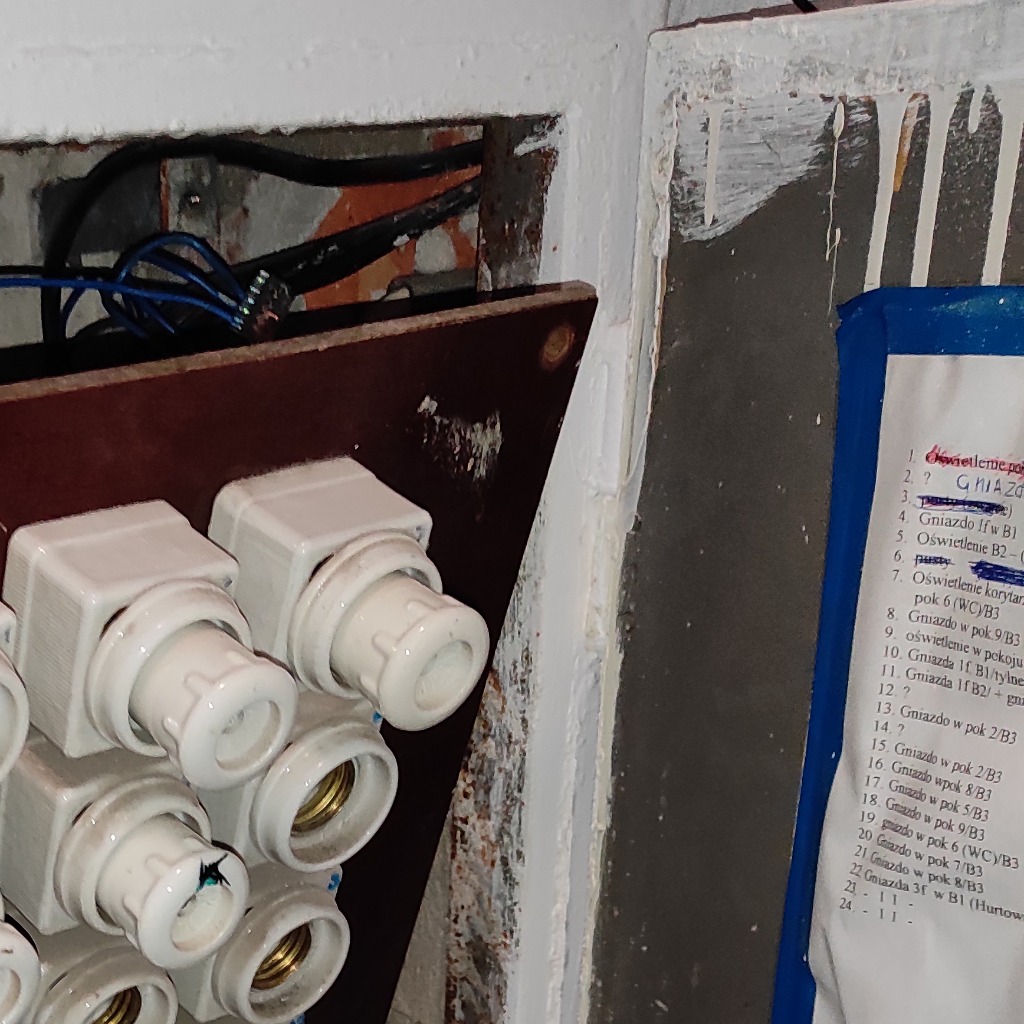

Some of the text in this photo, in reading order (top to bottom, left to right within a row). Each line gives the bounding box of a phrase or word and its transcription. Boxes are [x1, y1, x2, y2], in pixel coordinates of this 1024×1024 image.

[919, 512, 975, 530] Gniazdo
[917, 532, 988, 554] Oświetlenie
[992, 543, 1007, 558] B2
[912, 571, 982, 595] Oświetlenie
[914, 592, 938, 606] pok
[943, 595, 951, 607] 6
[908, 609, 957, 630] Gniazdo
[906, 630, 969, 653] oświetlenie
[984, 649, 1023, 669] pokoju
[908, 648, 954, 670] Gniazda
[905, 667, 953, 689] Gniazda
[900, 705, 950, 727] Gniazdo
[953, 719, 963, 729] w
[965, 722, 986, 736] pok
[988, 726, 1017, 745] 2/B3
[894, 742, 937, 765] Gniazdo
[940, 757, 950, 768] w
[951, 761, 973, 775] pok
[975, 765, 1002, 783] 2/B3
[891, 761, 932, 783] Gniazdo
[965, 783, 992, 801] 8/B3
[888, 779, 927, 802] Gniazdo
[939, 800, 961, 813] pok
[886, 797, 921, 820] Gniazdo
[934, 819, 955, 832] pok
[876, 833, 911, 857] Gniazdo
[927, 856, 949, 869] pok
[927, 836, 949, 850] pok
[951, 841, 959, 853] 6
[864, 868, 909, 892] Gniazda
[870, 852, 909, 875] Gniazdo
[928, 873, 951, 886] pok
[954, 877, 984, 894] 8/B3
